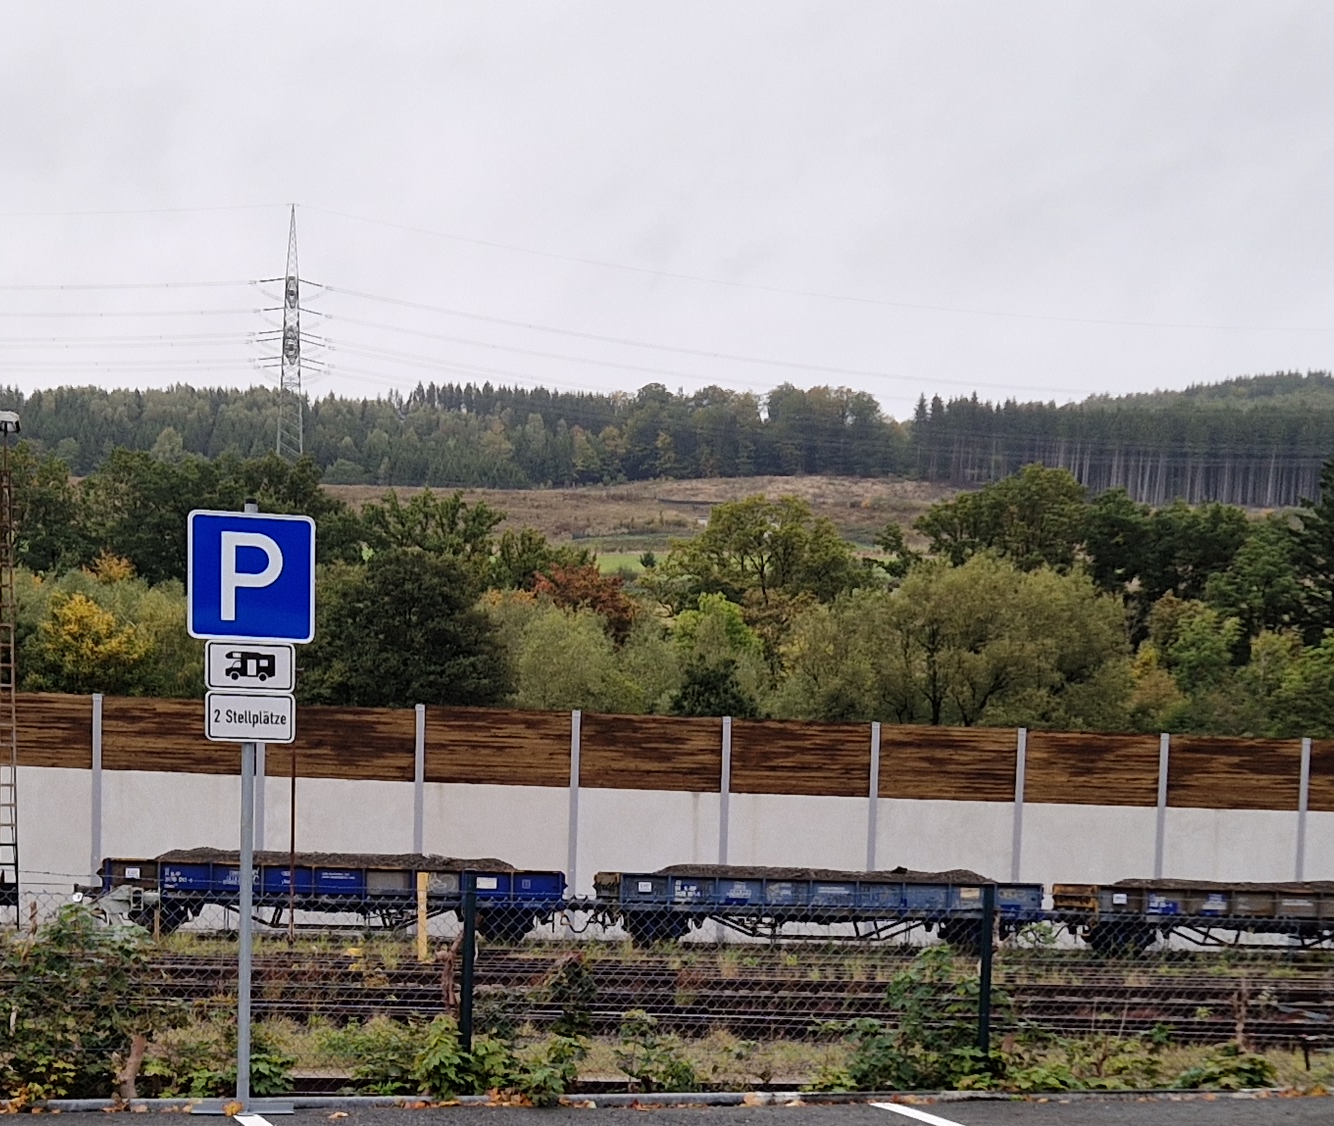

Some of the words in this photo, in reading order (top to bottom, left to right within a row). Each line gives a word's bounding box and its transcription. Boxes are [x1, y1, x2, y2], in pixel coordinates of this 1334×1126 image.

[220, 530, 284, 621] P
[213, 709, 221, 723] 2
[225, 709, 287, 728] Stellplätze
